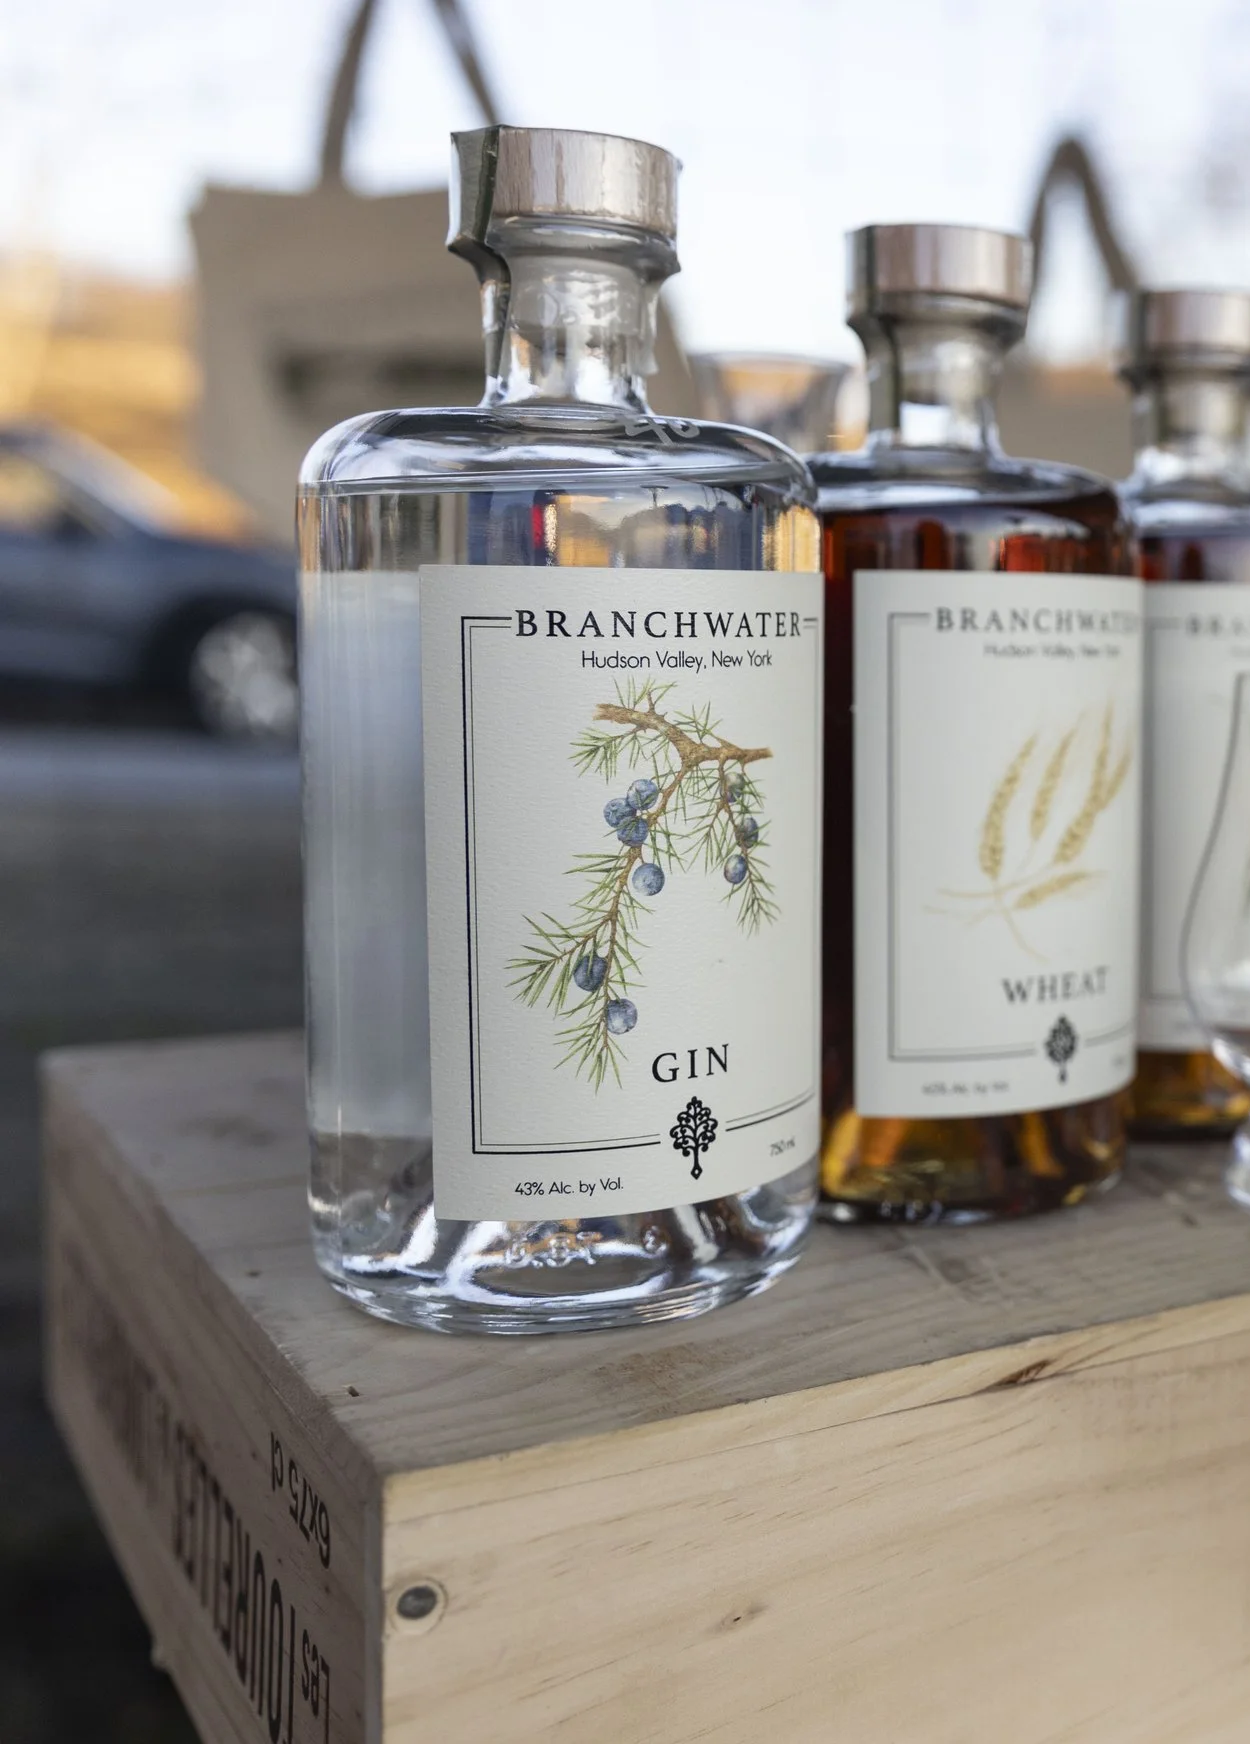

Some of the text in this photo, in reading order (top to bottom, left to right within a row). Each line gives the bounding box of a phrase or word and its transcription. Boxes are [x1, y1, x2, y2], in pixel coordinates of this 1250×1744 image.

[514, 609, 802, 639] BRANCHWATER
[935, 606, 1138, 634] BRANCHWAT
[581, 649, 773, 674] Hudson Valley, New York
[1000, 964, 1109, 1004] WHEAT
[651, 1043, 730, 1084] GIN
[514, 1176, 624, 1197] 43% Alc. by Vol.
[270, 1431, 284, 1493] cl
